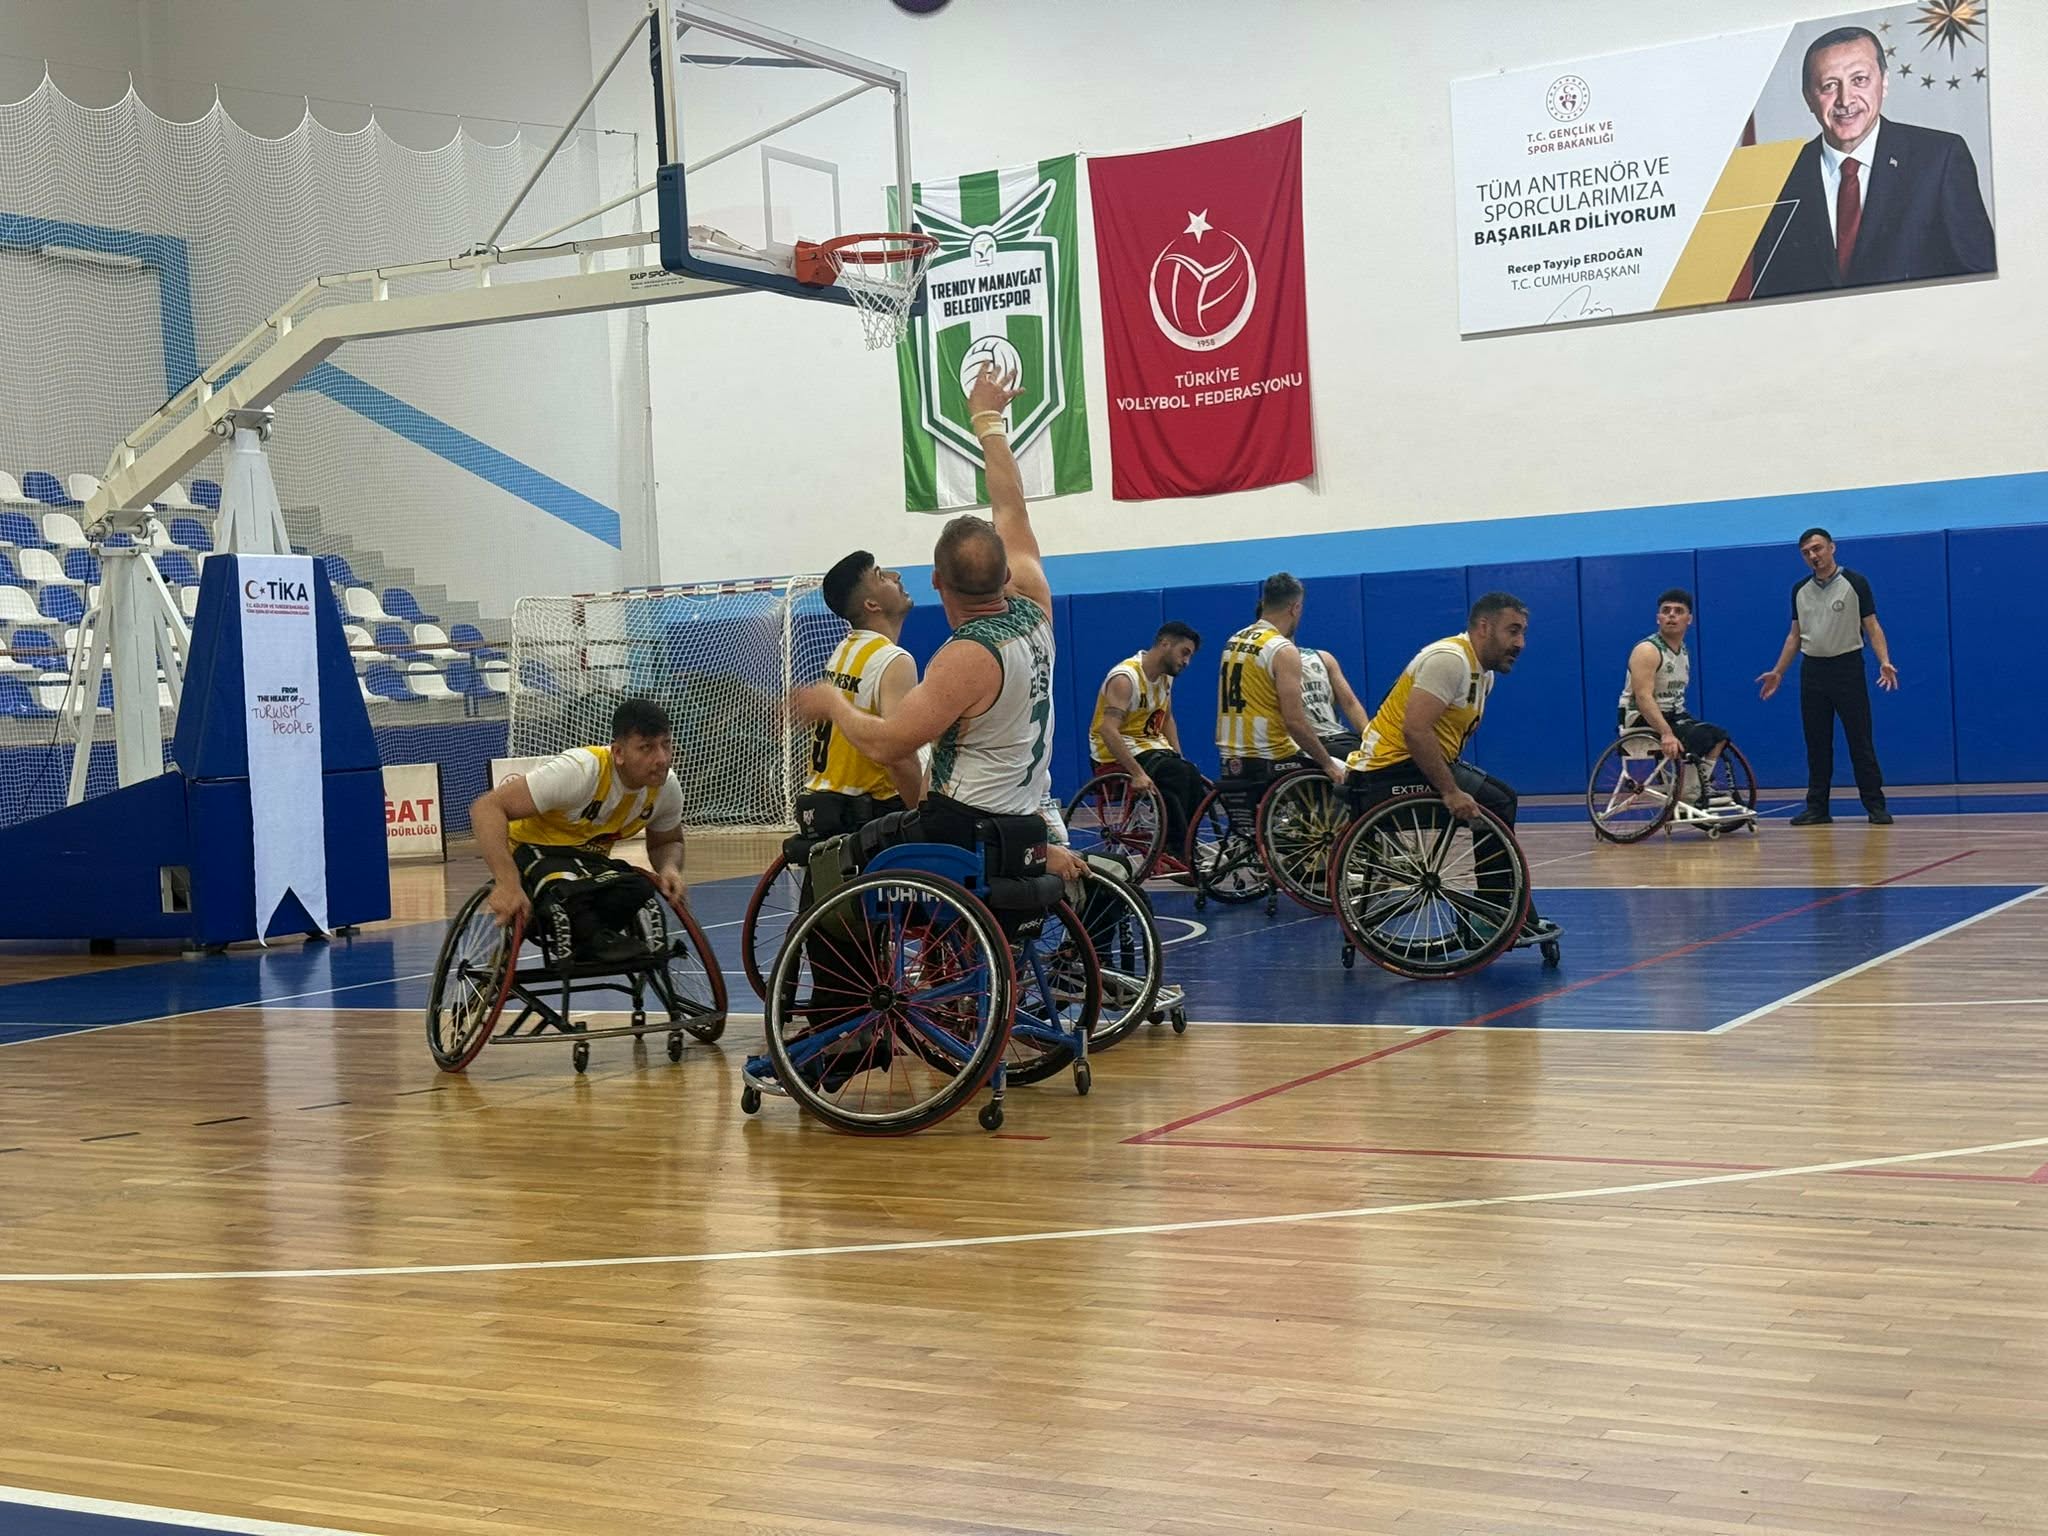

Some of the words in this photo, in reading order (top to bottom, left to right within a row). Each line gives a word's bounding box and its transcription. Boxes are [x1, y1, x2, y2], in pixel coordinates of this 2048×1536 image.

[1527, 132, 1546, 143] T.C.
[1549, 123, 1596, 138] GENÇLİK
[1599, 121, 1613, 131] VE
[1527, 143, 1554, 155] SPOR
[1558, 133, 1614, 150] BAKANLIĞI
[1476, 179, 1521, 202] TÜM
[1528, 161, 1639, 195] ANTRENÖR
[1644, 156, 1670, 177] VE
[1484, 180, 1665, 223] SPORCULARIMIZA
[1474, 219, 1571, 245] BAŞARILAR
[1575, 203, 1676, 231] DİLİYORUM
[1507, 263, 1541, 275] Recep
[1543, 256, 1581, 271] Tayyip
[1584, 247, 1643, 265] ERDOĞAN
[931, 278, 976, 300] TRENDY
[979, 267, 1042, 293] MANAVGAT
[1511, 278, 1531, 291] T.C.
[1534, 264, 1640, 288] CUMHURBAŞKANI
[943, 289, 1031, 317] BELEDİYESPOR
[1197, 339, 1215, 347] 1958
[1116, 394, 1190, 411] VOLEYBOL
[1195, 372, 1302, 407] FEDERASYONU
[1175, 367, 1240, 389] TÜRKİYE
[266, 578, 309, 601] TİKA
[1221, 661, 1246, 714] 14
[251, 703, 298, 719] TURKISH
[273, 720, 314, 734] PEOPLE
[1391, 784, 1433, 795] EXTRA
